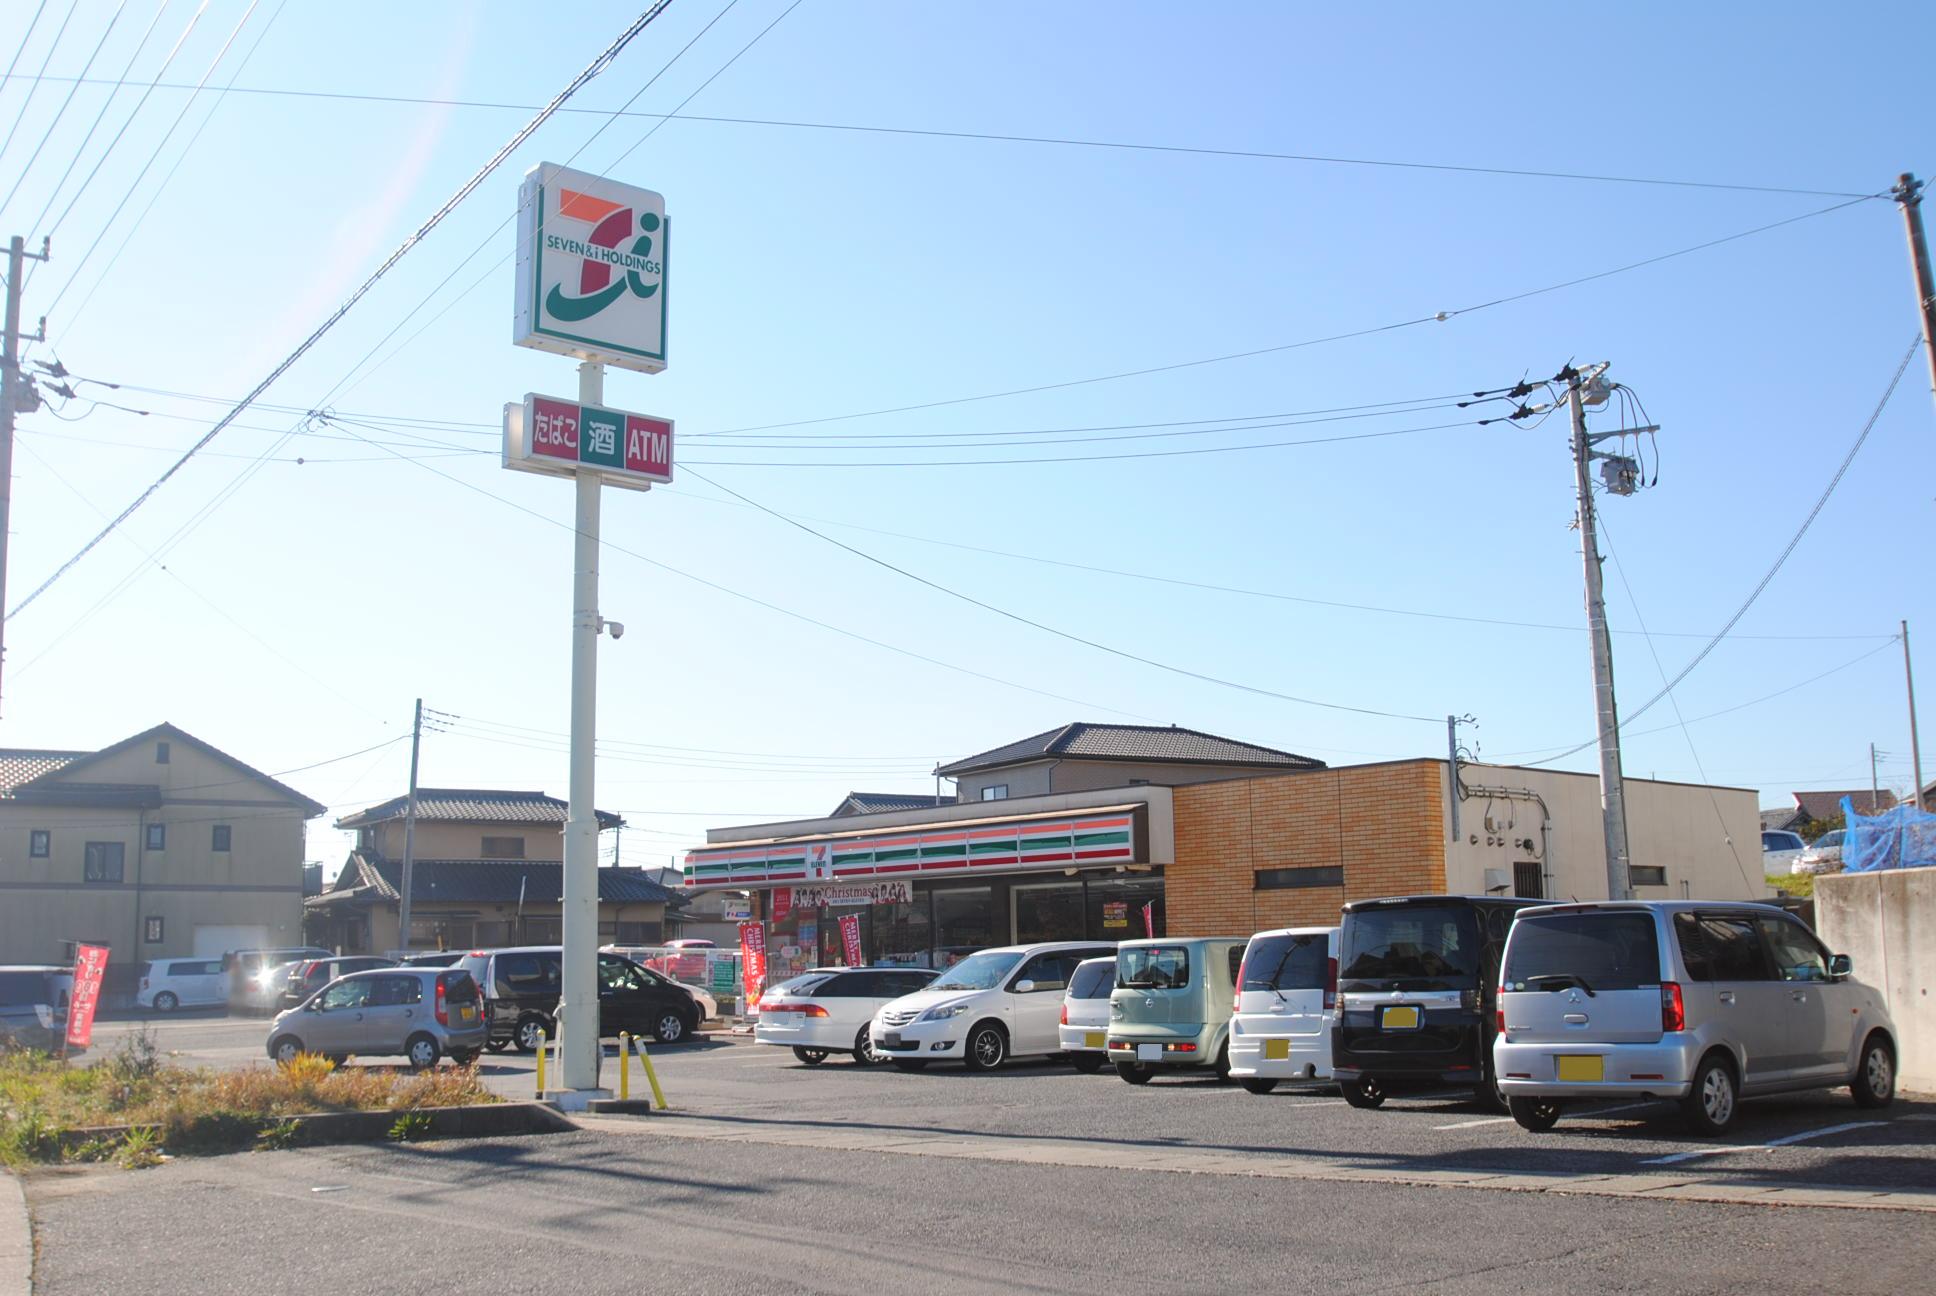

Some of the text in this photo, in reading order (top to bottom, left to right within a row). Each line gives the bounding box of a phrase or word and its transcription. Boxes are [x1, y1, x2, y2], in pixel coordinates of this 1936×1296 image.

[601, 248, 661, 275] HOLDINGS
[534, 411, 577, 448] たばこ
[588, 420, 616, 455] 酒
[628, 429, 668, 465] ATM
[824, 886, 872, 899] Christmas
[747, 928, 758, 976] CHRISTMAS
